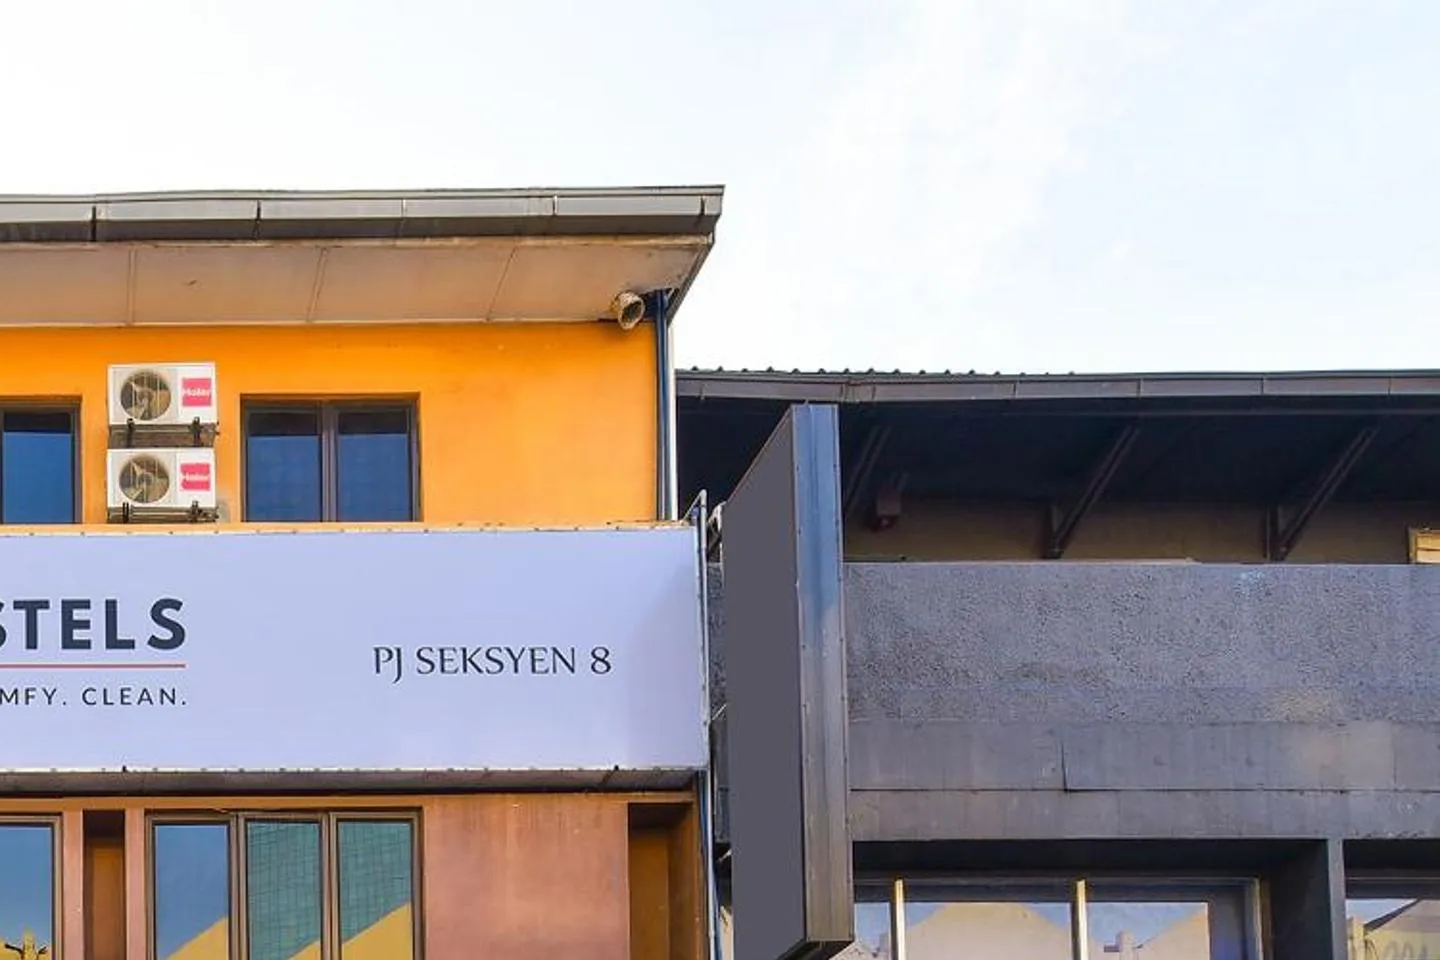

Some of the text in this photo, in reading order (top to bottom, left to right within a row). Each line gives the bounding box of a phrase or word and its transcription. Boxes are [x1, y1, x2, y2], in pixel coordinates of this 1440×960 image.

[373, 646, 612, 684] PJ SEKSYEN 8
[82, 687, 187, 706] CLEAN.
